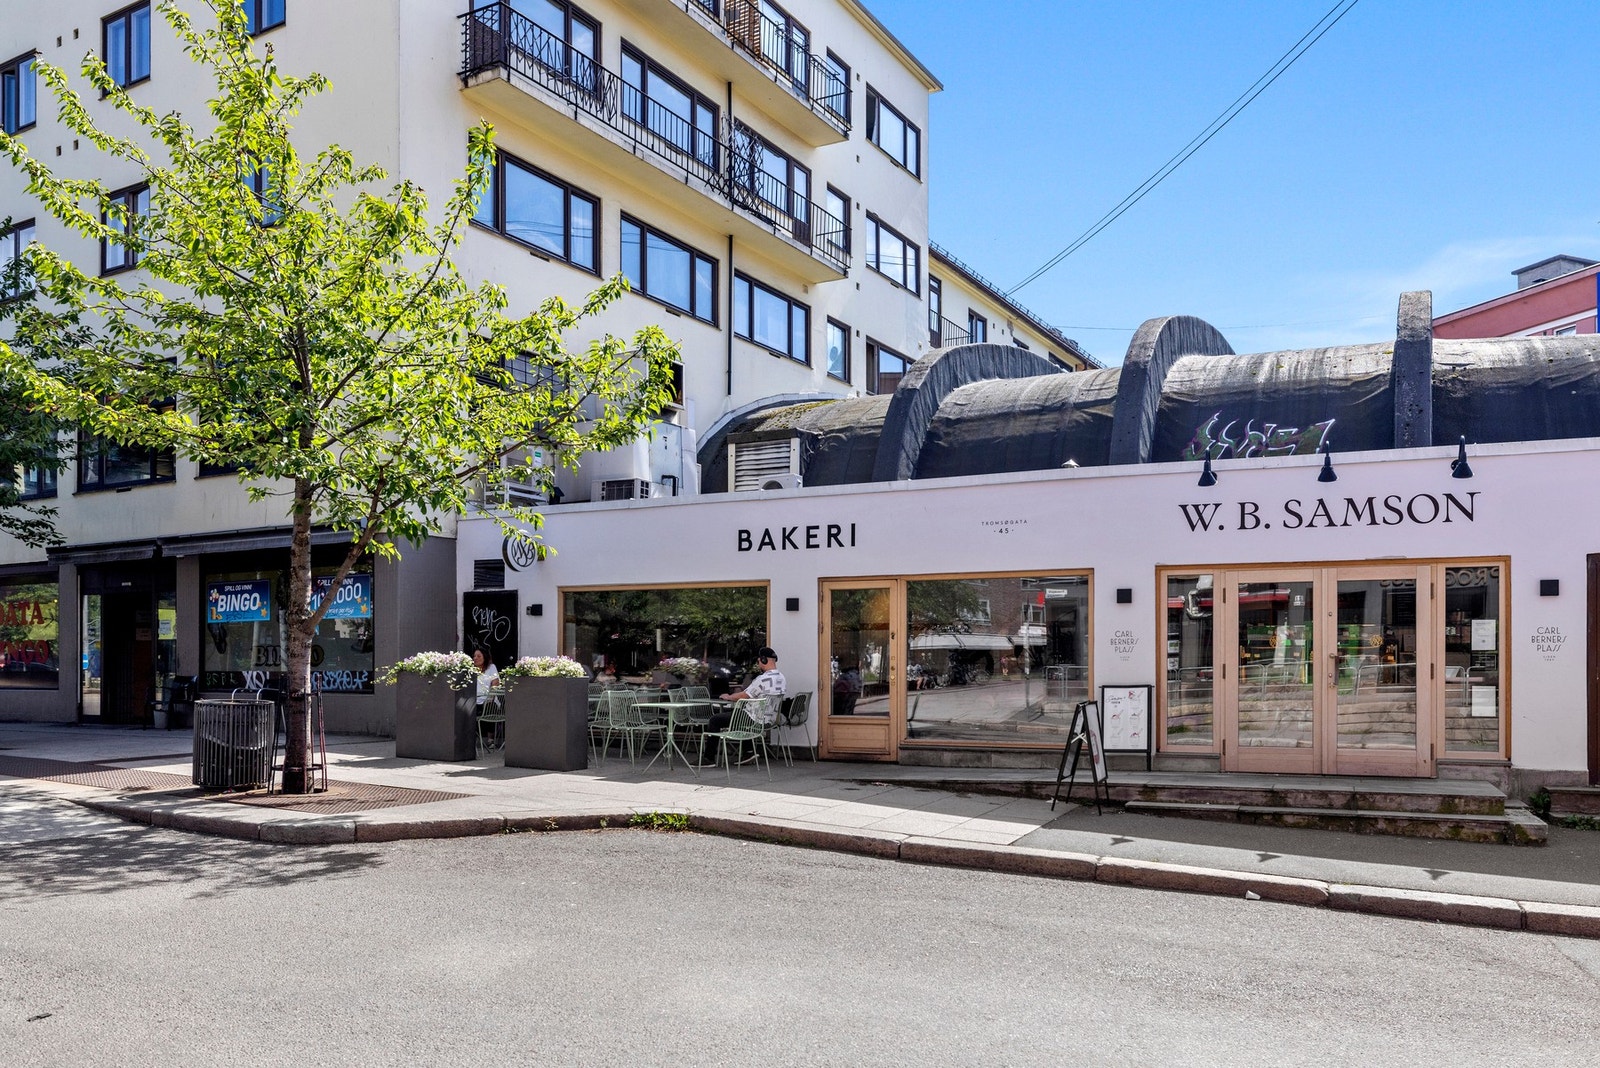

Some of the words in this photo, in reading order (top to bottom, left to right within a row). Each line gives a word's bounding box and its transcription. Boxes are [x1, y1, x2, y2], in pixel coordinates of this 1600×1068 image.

[1178, 502, 1225, 532] W.
[1237, 501, 1271, 531] B.
[1282, 491, 1482, 529] SAMSON
[737, 522, 856, 552] BAKERI
[217, 592, 261, 613] BINGO
[1114, 630, 1134, 638] CARL
[1536, 626, 1561, 635] CARL
[1110, 638, 1140, 646] BERNERS
[1531, 635, 1568, 644] BERNERS
[1114, 645, 1135, 653] PLASS
[1536, 644, 1562, 652] PLASS
